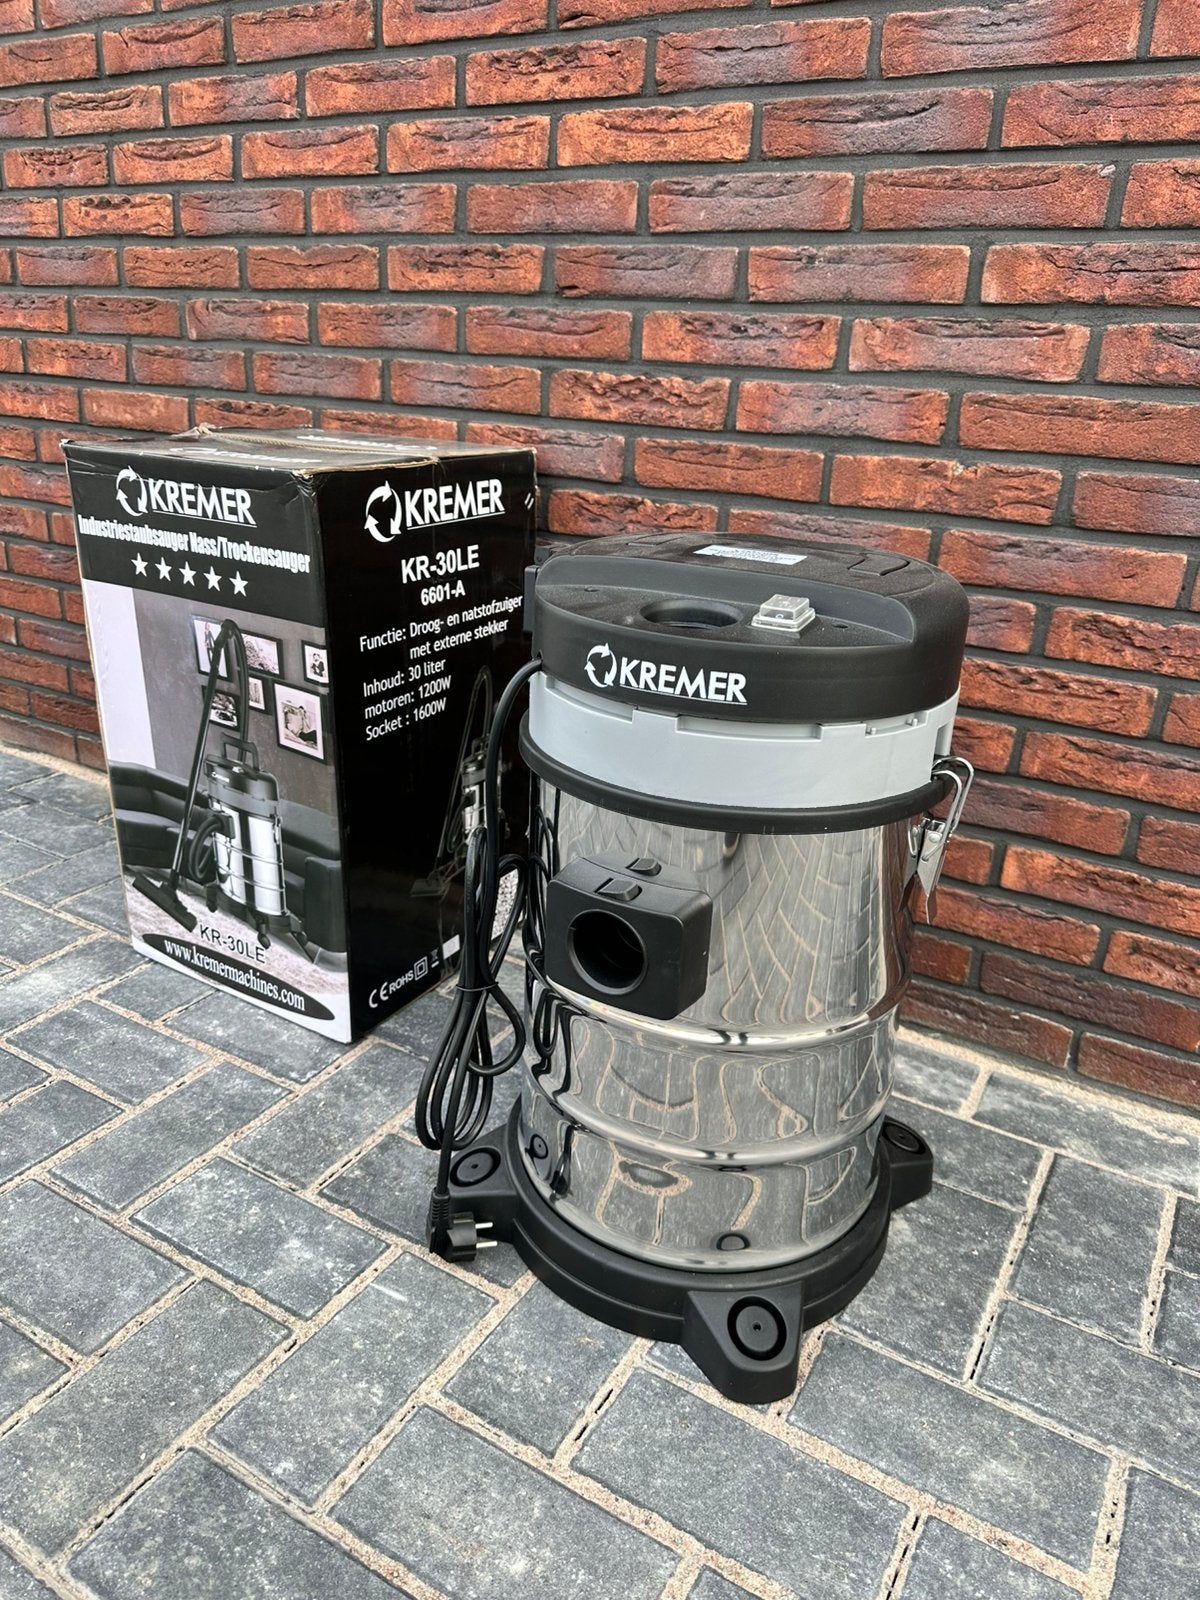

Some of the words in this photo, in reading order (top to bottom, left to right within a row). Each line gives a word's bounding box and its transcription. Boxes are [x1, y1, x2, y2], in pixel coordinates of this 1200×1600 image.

[149, 478, 256, 526] KREMER
[404, 478, 505, 528] KREMER
[78, 514, 188, 552] Industriestaubsauger
[188, 532, 311, 574] Nass/Trockensauger
[401, 544, 480, 584] KR-30LE
[420, 579, 466, 606] 6601-A
[359, 629, 407, 652] Functie:
[409, 619, 444, 638] Droog-
[447, 612, 460, 627] en
[462, 595, 523, 622] natstofzuiger
[410, 642, 431, 659] met
[434, 633, 478, 652] externe
[474, 619, 509, 640] stekker
[363, 671, 405, 698] Inhoud:
[408, 665, 422, 682] 30
[423, 658, 446, 678] liter
[364, 690, 415, 720] motoren:
[418, 674, 452, 700] 1200W
[619, 656, 748, 704] KREMER
[365, 713, 403, 741] Socket
[413, 696, 447, 723] 1600W
[199, 924, 266, 964] KR-30LE
[164, 938, 306, 1012] www.kremermachines.com
[389, 970, 414, 995] ROHS
